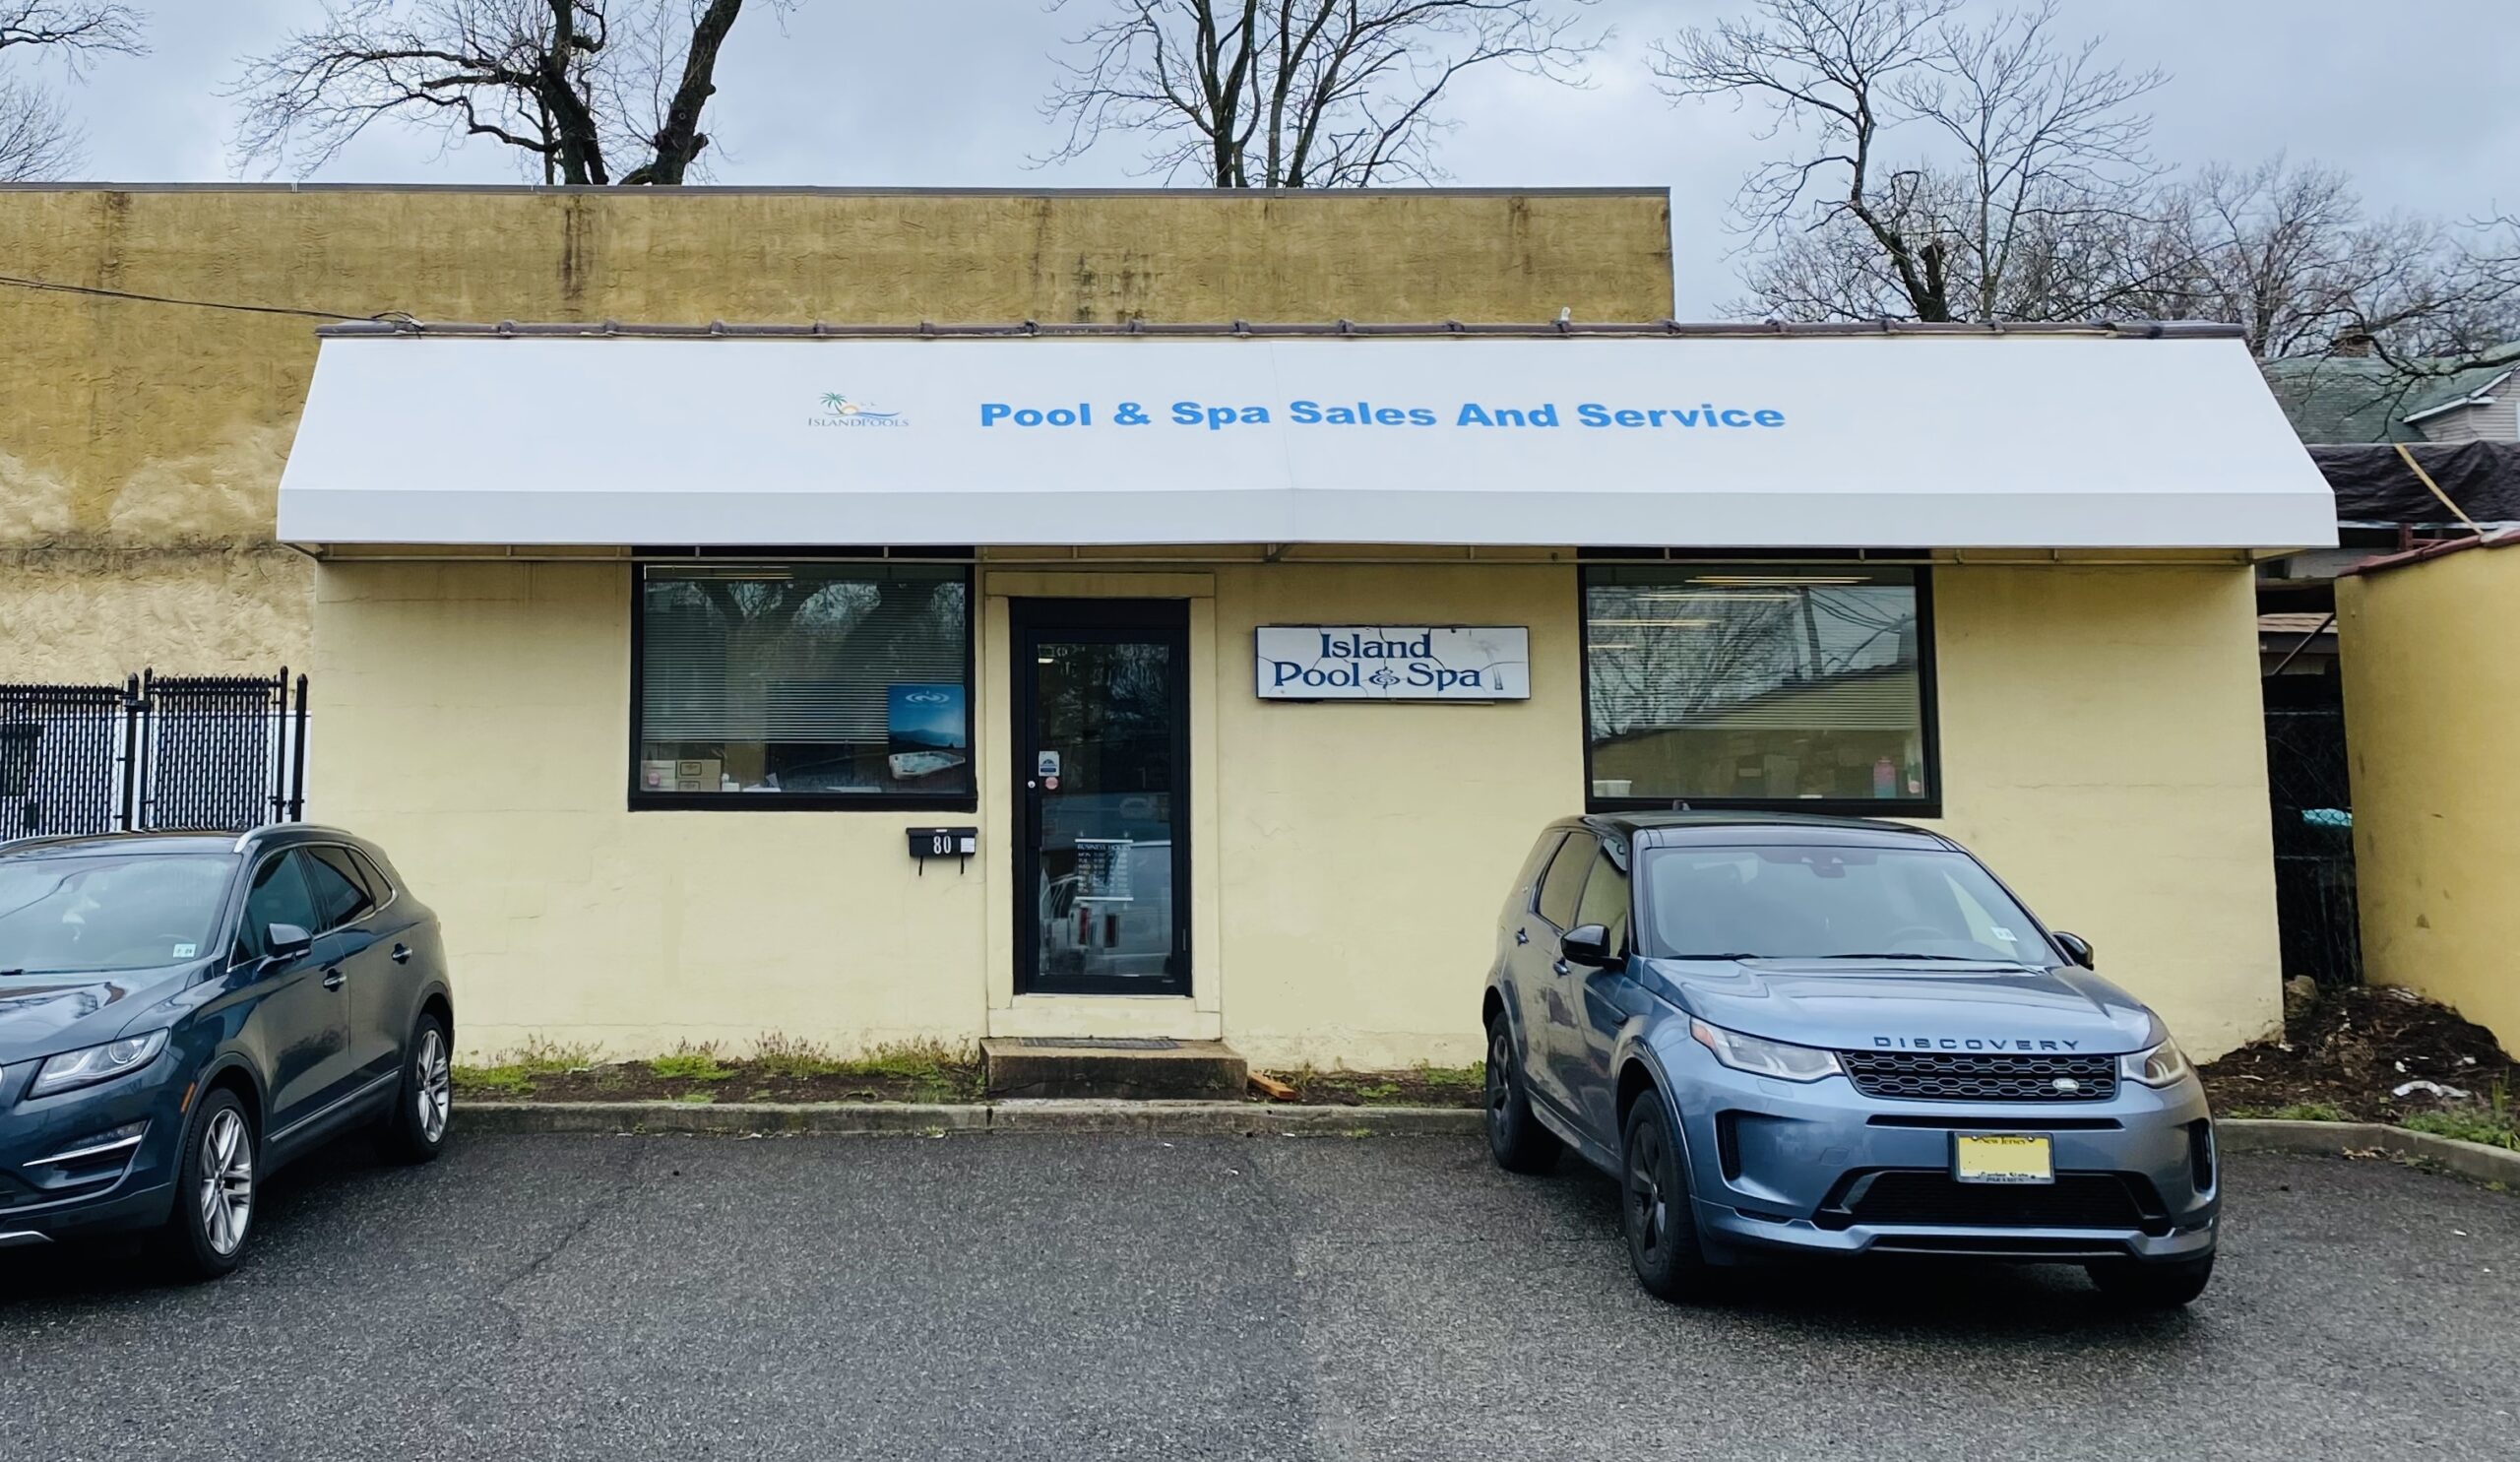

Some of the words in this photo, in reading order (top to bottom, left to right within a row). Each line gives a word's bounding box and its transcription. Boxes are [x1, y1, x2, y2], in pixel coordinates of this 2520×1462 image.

[978, 401, 1092, 429] Pool
[1112, 401, 1152, 427] &
[1170, 400, 1272, 433] Spa
[1288, 400, 1438, 427] Sales
[1455, 402, 1560, 430] And
[1575, 402, 1786, 430] Service
[1321, 633, 1433, 659] Island
[1274, 661, 1361, 687] Pool
[1367, 666, 1401, 689] &
[1407, 662, 1482, 691] Spa
[933, 835, 952, 855] 80
[1873, 1037, 2079, 1051] DISCOVERY
